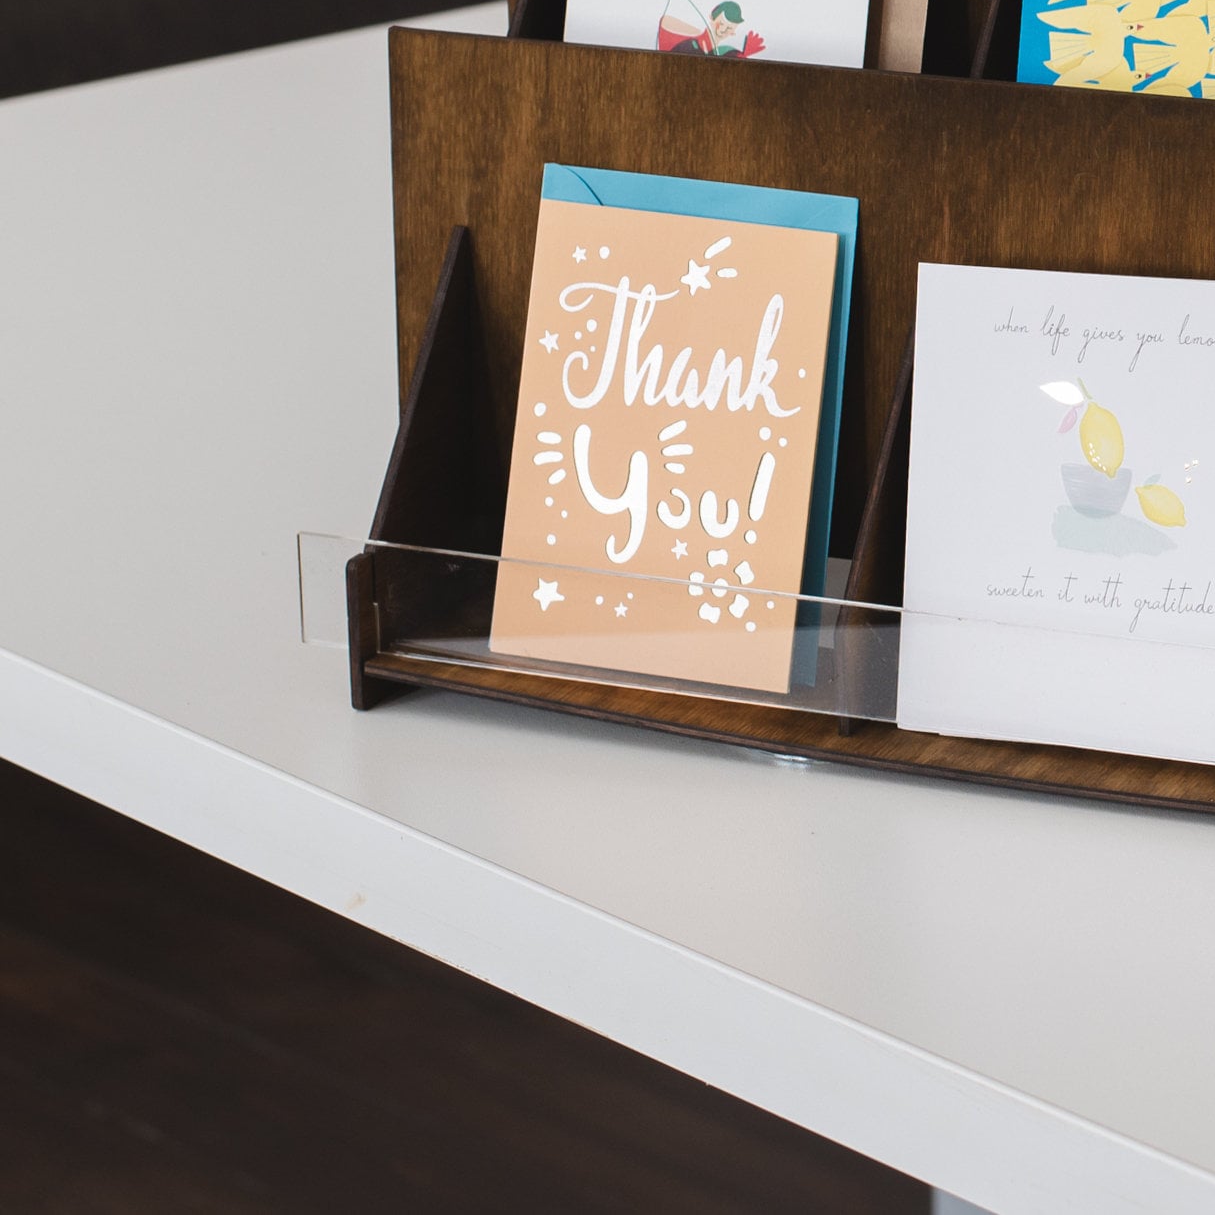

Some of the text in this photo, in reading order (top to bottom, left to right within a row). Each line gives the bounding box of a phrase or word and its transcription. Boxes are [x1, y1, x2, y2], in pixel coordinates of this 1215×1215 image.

[559, 276, 801, 418] Thank
[993, 306, 1030, 334] when
[1040, 305, 1071, 356] life
[1083, 328, 1125, 363] gives
[1128, 330, 1165, 373] you
[986, 566, 1215, 634] sweeten it with gratitude
